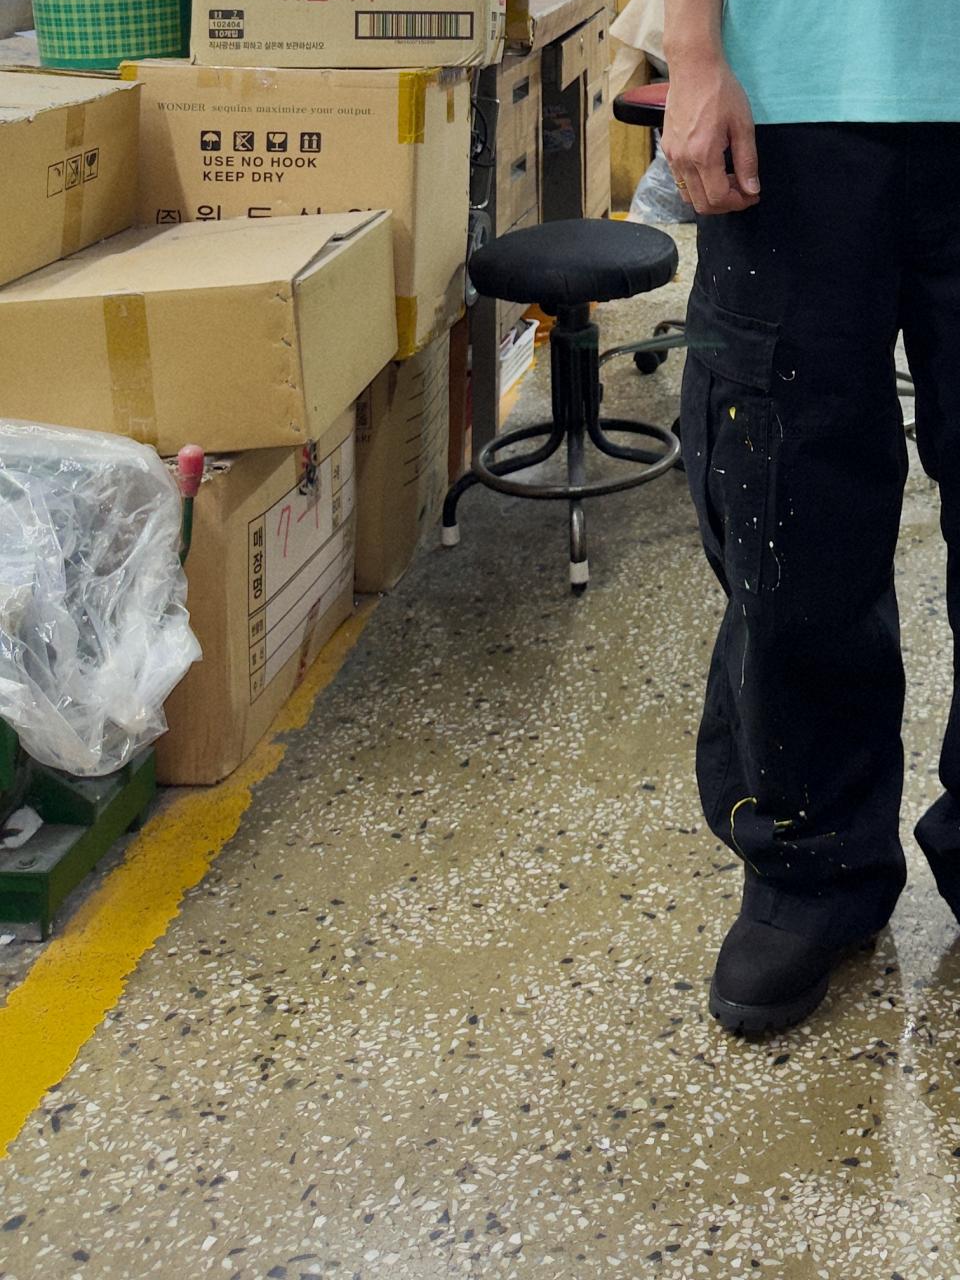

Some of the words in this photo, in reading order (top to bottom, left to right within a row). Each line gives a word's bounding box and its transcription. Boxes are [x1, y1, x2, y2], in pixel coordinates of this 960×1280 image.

[156, 102, 206, 112] WONDER
[211, 104, 252, 114] sequins
[256, 104, 308, 114] maximize
[310, 107, 334, 116] your
[203, 155, 235, 167] USE
[241, 156, 264, 167] NO
[270, 156, 318, 168] HOOK
[203, 171, 245, 182] KEEP
[251, 172, 285, 183] DRY
